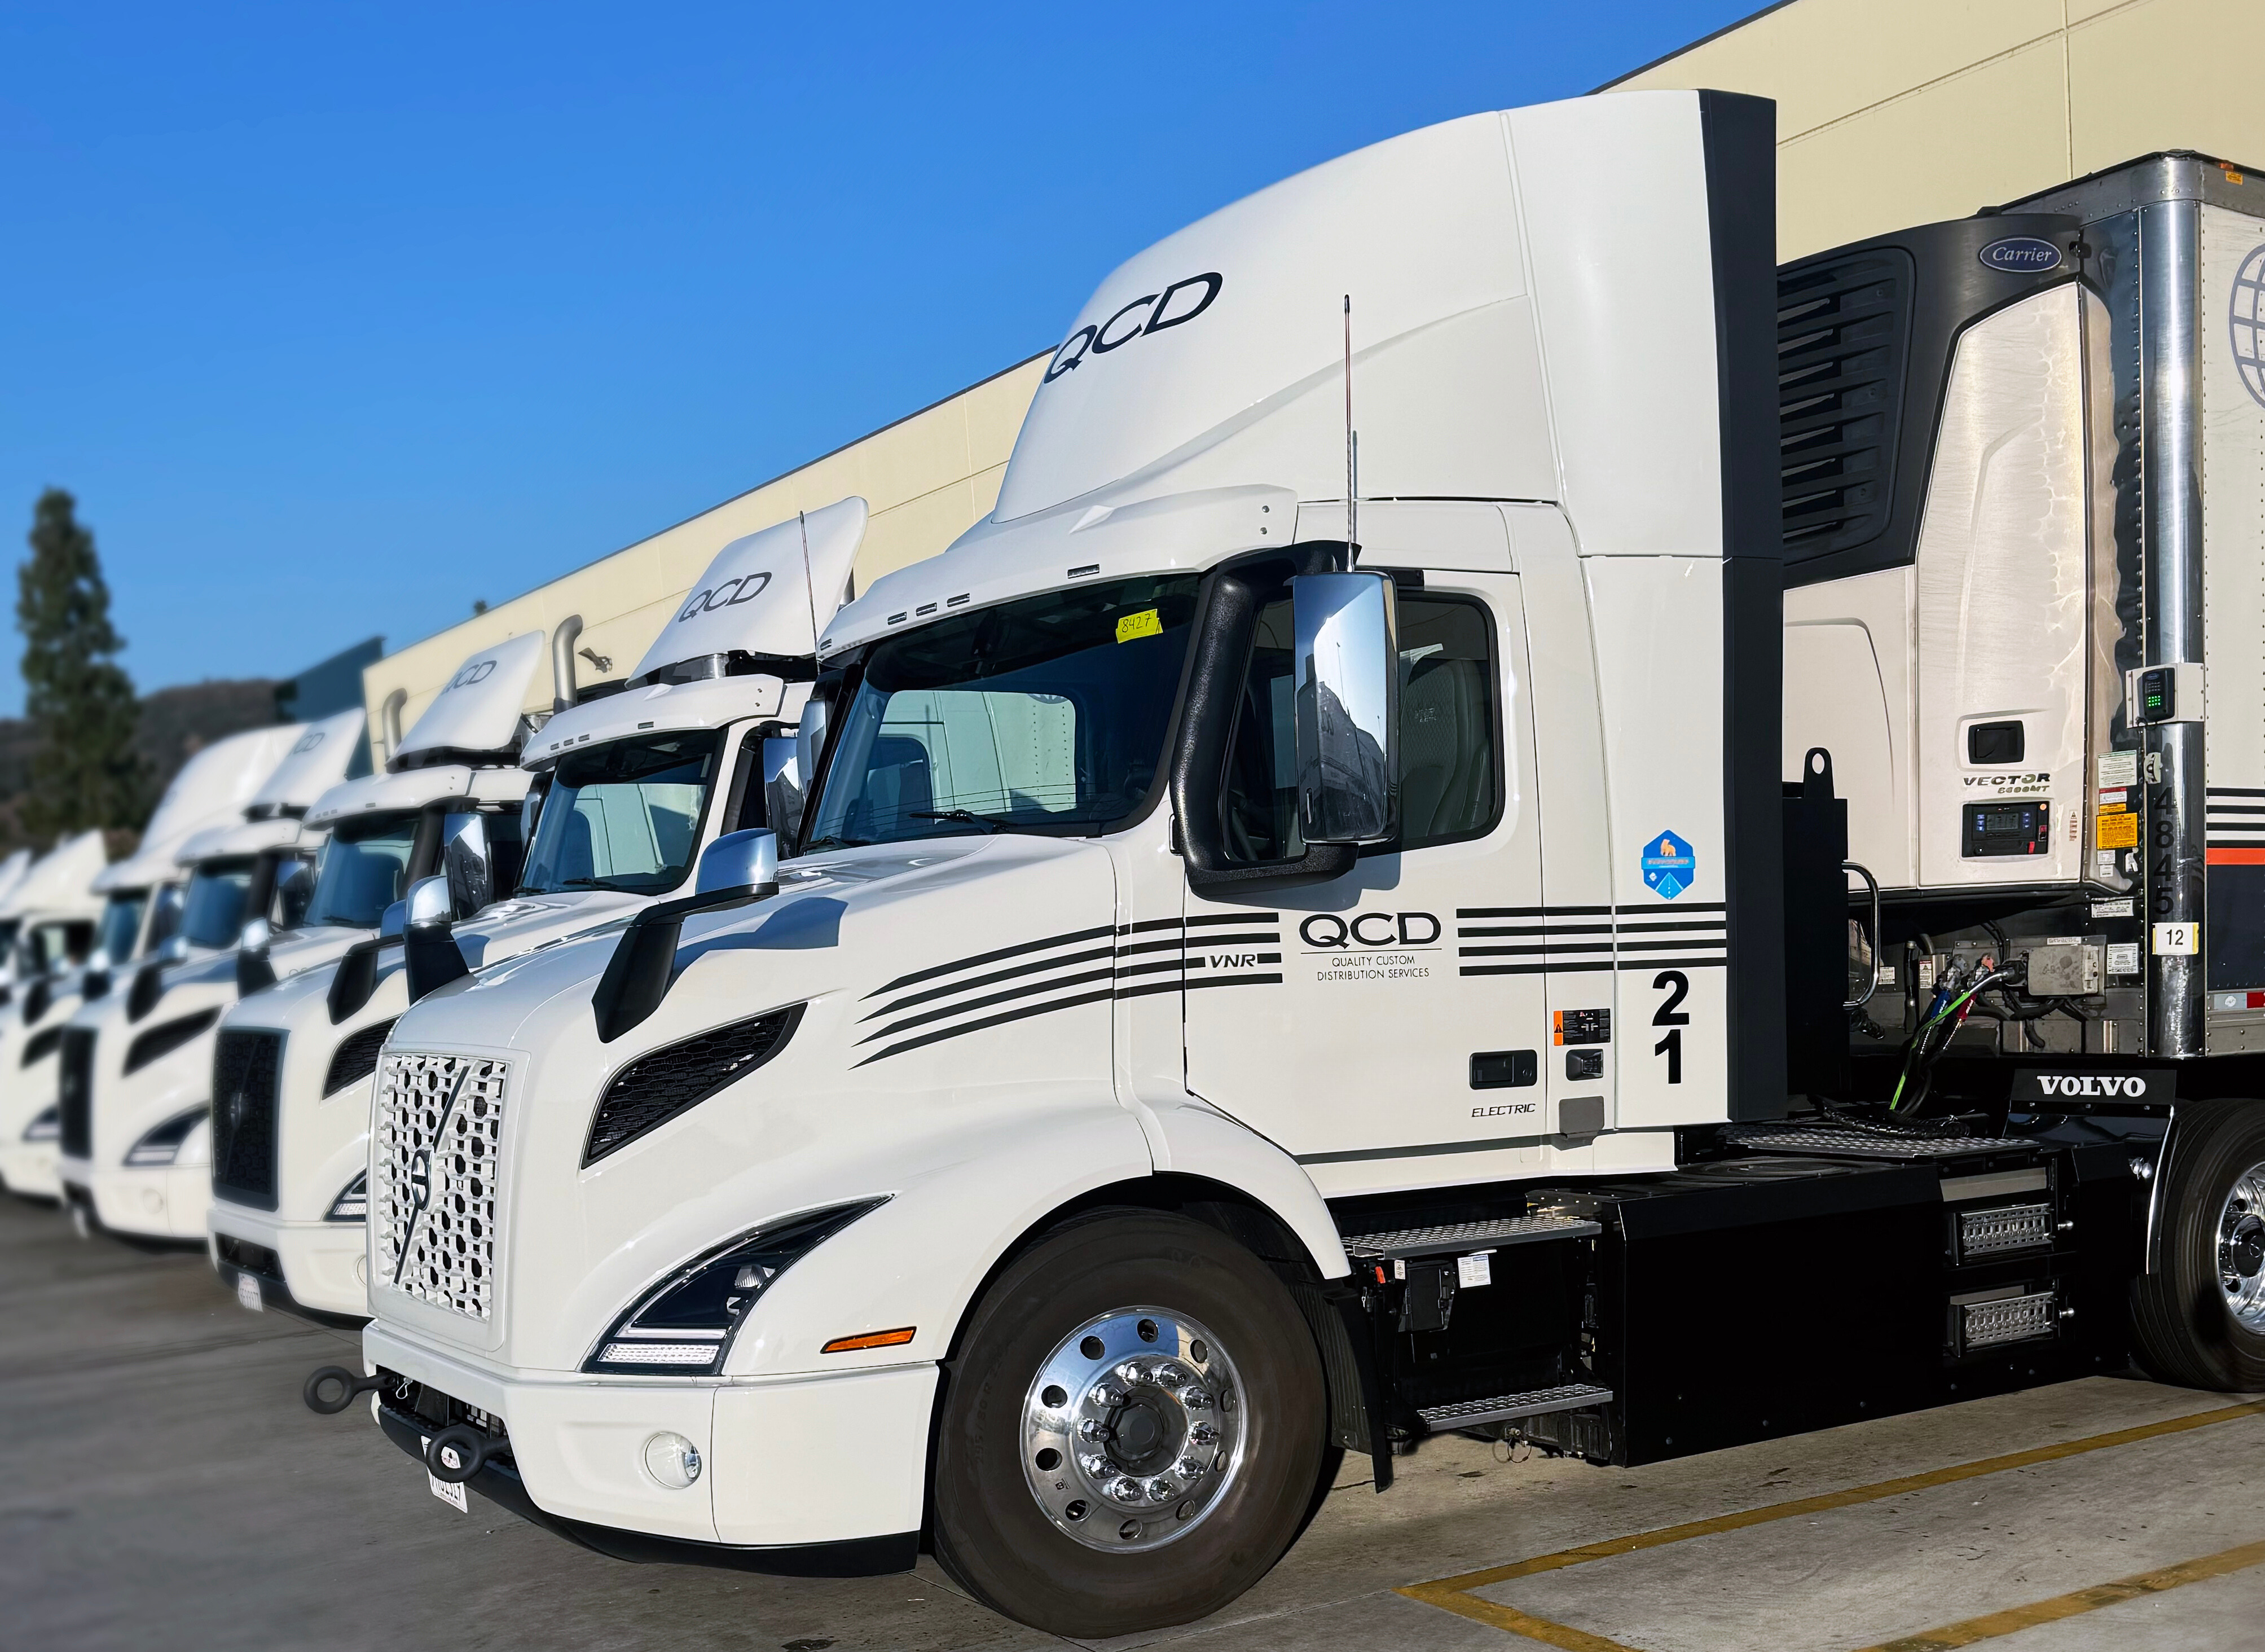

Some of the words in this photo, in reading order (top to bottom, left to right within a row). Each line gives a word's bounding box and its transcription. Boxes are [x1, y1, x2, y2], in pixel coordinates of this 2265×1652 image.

[1993, 247, 2052, 262] Carrier
[1044, 272, 1224, 384] QCD
[678, 572, 772, 623] QCD
[1121, 613, 1151, 633] 8427
[1963, 773, 2051, 787] VECTOR
[1299, 912, 1442, 950] QCD
[2166, 929, 2184, 946] 12
[1208, 954, 1256, 969] VNR
[1332, 956, 1373, 968] QUALITY
[1376, 955, 1416, 966] CUSTOM
[1317, 969, 1384, 982] DISTRIBUTION
[1388, 968, 1430, 979] SERVICES
[2037, 1075, 2146, 1097] VOLVO
[1471, 1103, 1536, 1118] ELECTRIC
